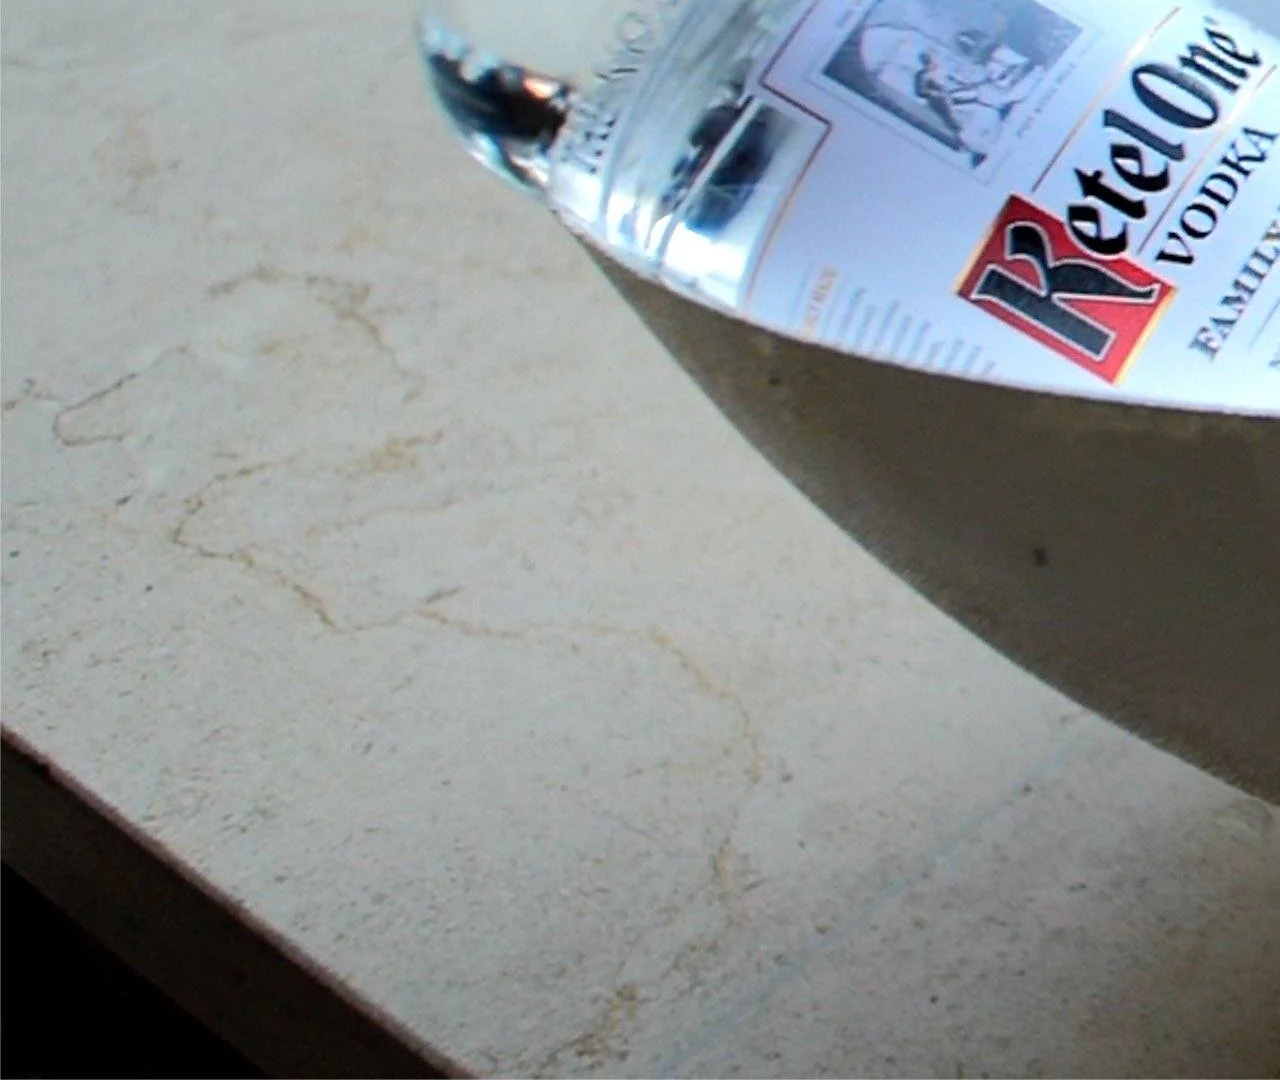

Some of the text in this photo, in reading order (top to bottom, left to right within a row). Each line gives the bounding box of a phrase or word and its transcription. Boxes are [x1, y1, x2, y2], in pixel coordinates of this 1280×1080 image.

[970, 25, 1262, 361] Ketel One
[1154, 125, 1280, 266] VODKA
